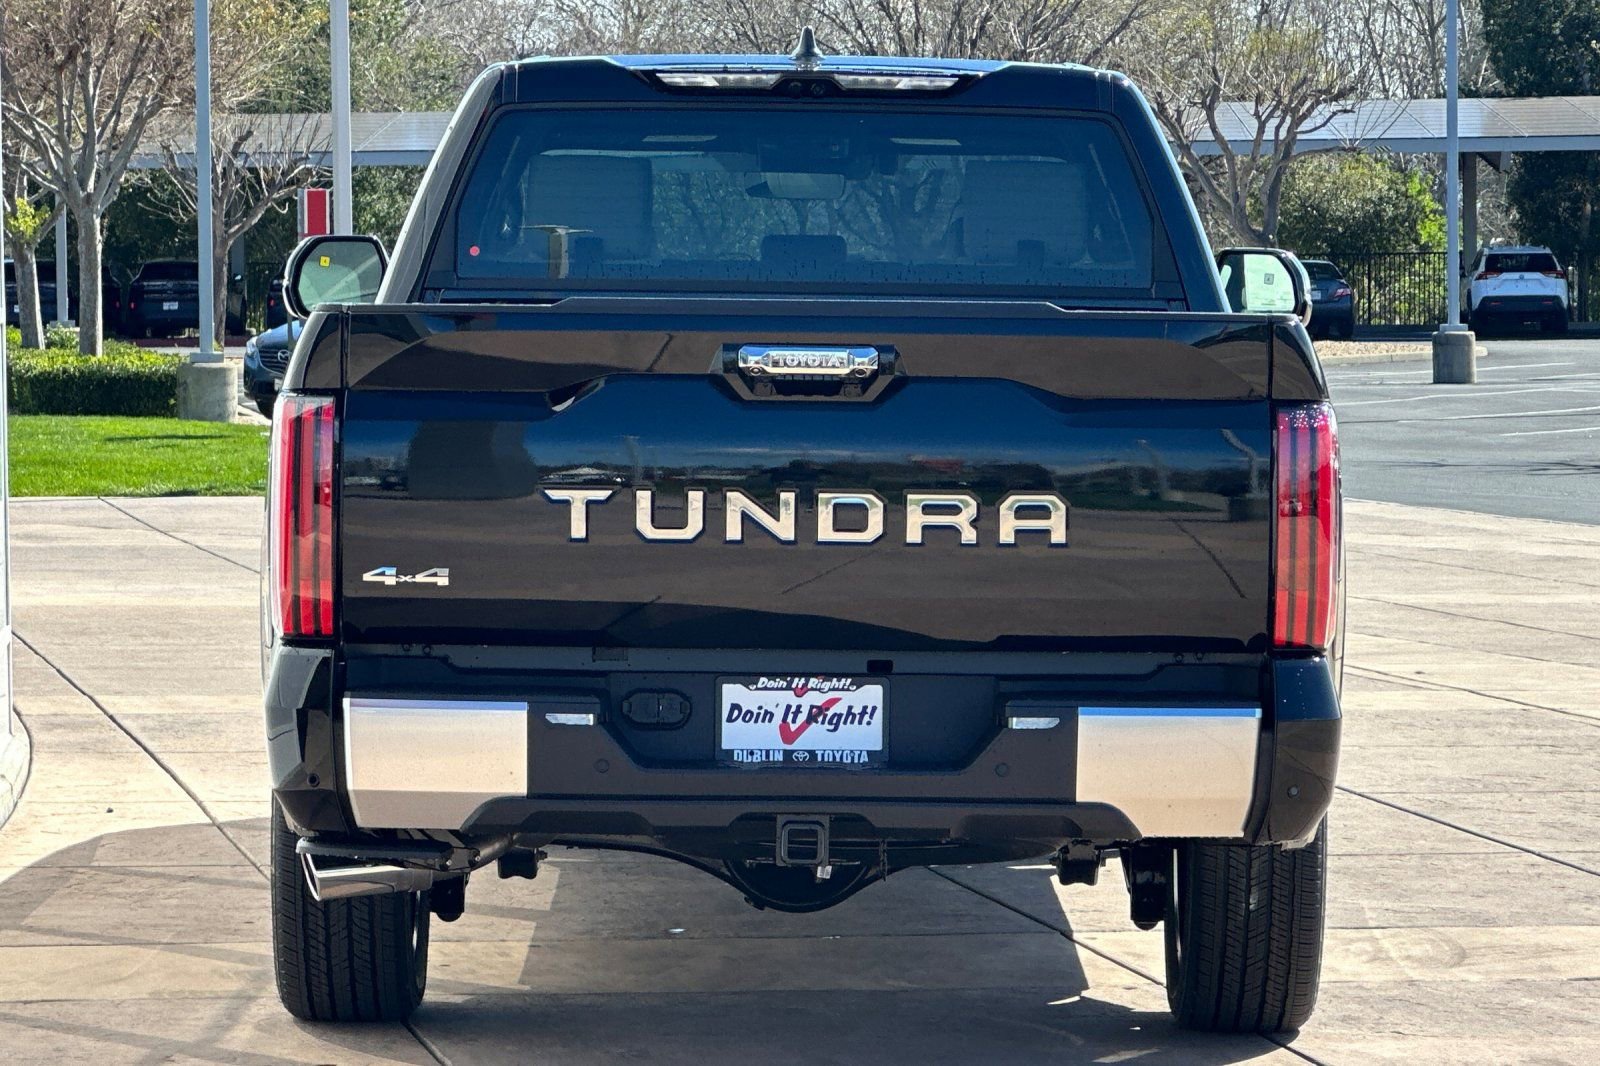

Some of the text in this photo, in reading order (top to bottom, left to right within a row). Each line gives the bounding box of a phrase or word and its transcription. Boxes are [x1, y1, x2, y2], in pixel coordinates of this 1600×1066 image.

[773, 352, 841, 368] TOYOTA
[543, 488, 1069, 545] TUNDRA
[362, 566, 450, 586] 4x4
[757, 676, 853, 692] Doin' It Right!
[726, 703, 878, 732] Doin' It Right!
[733, 750, 869, 763] DUBLIN TOYOTA
